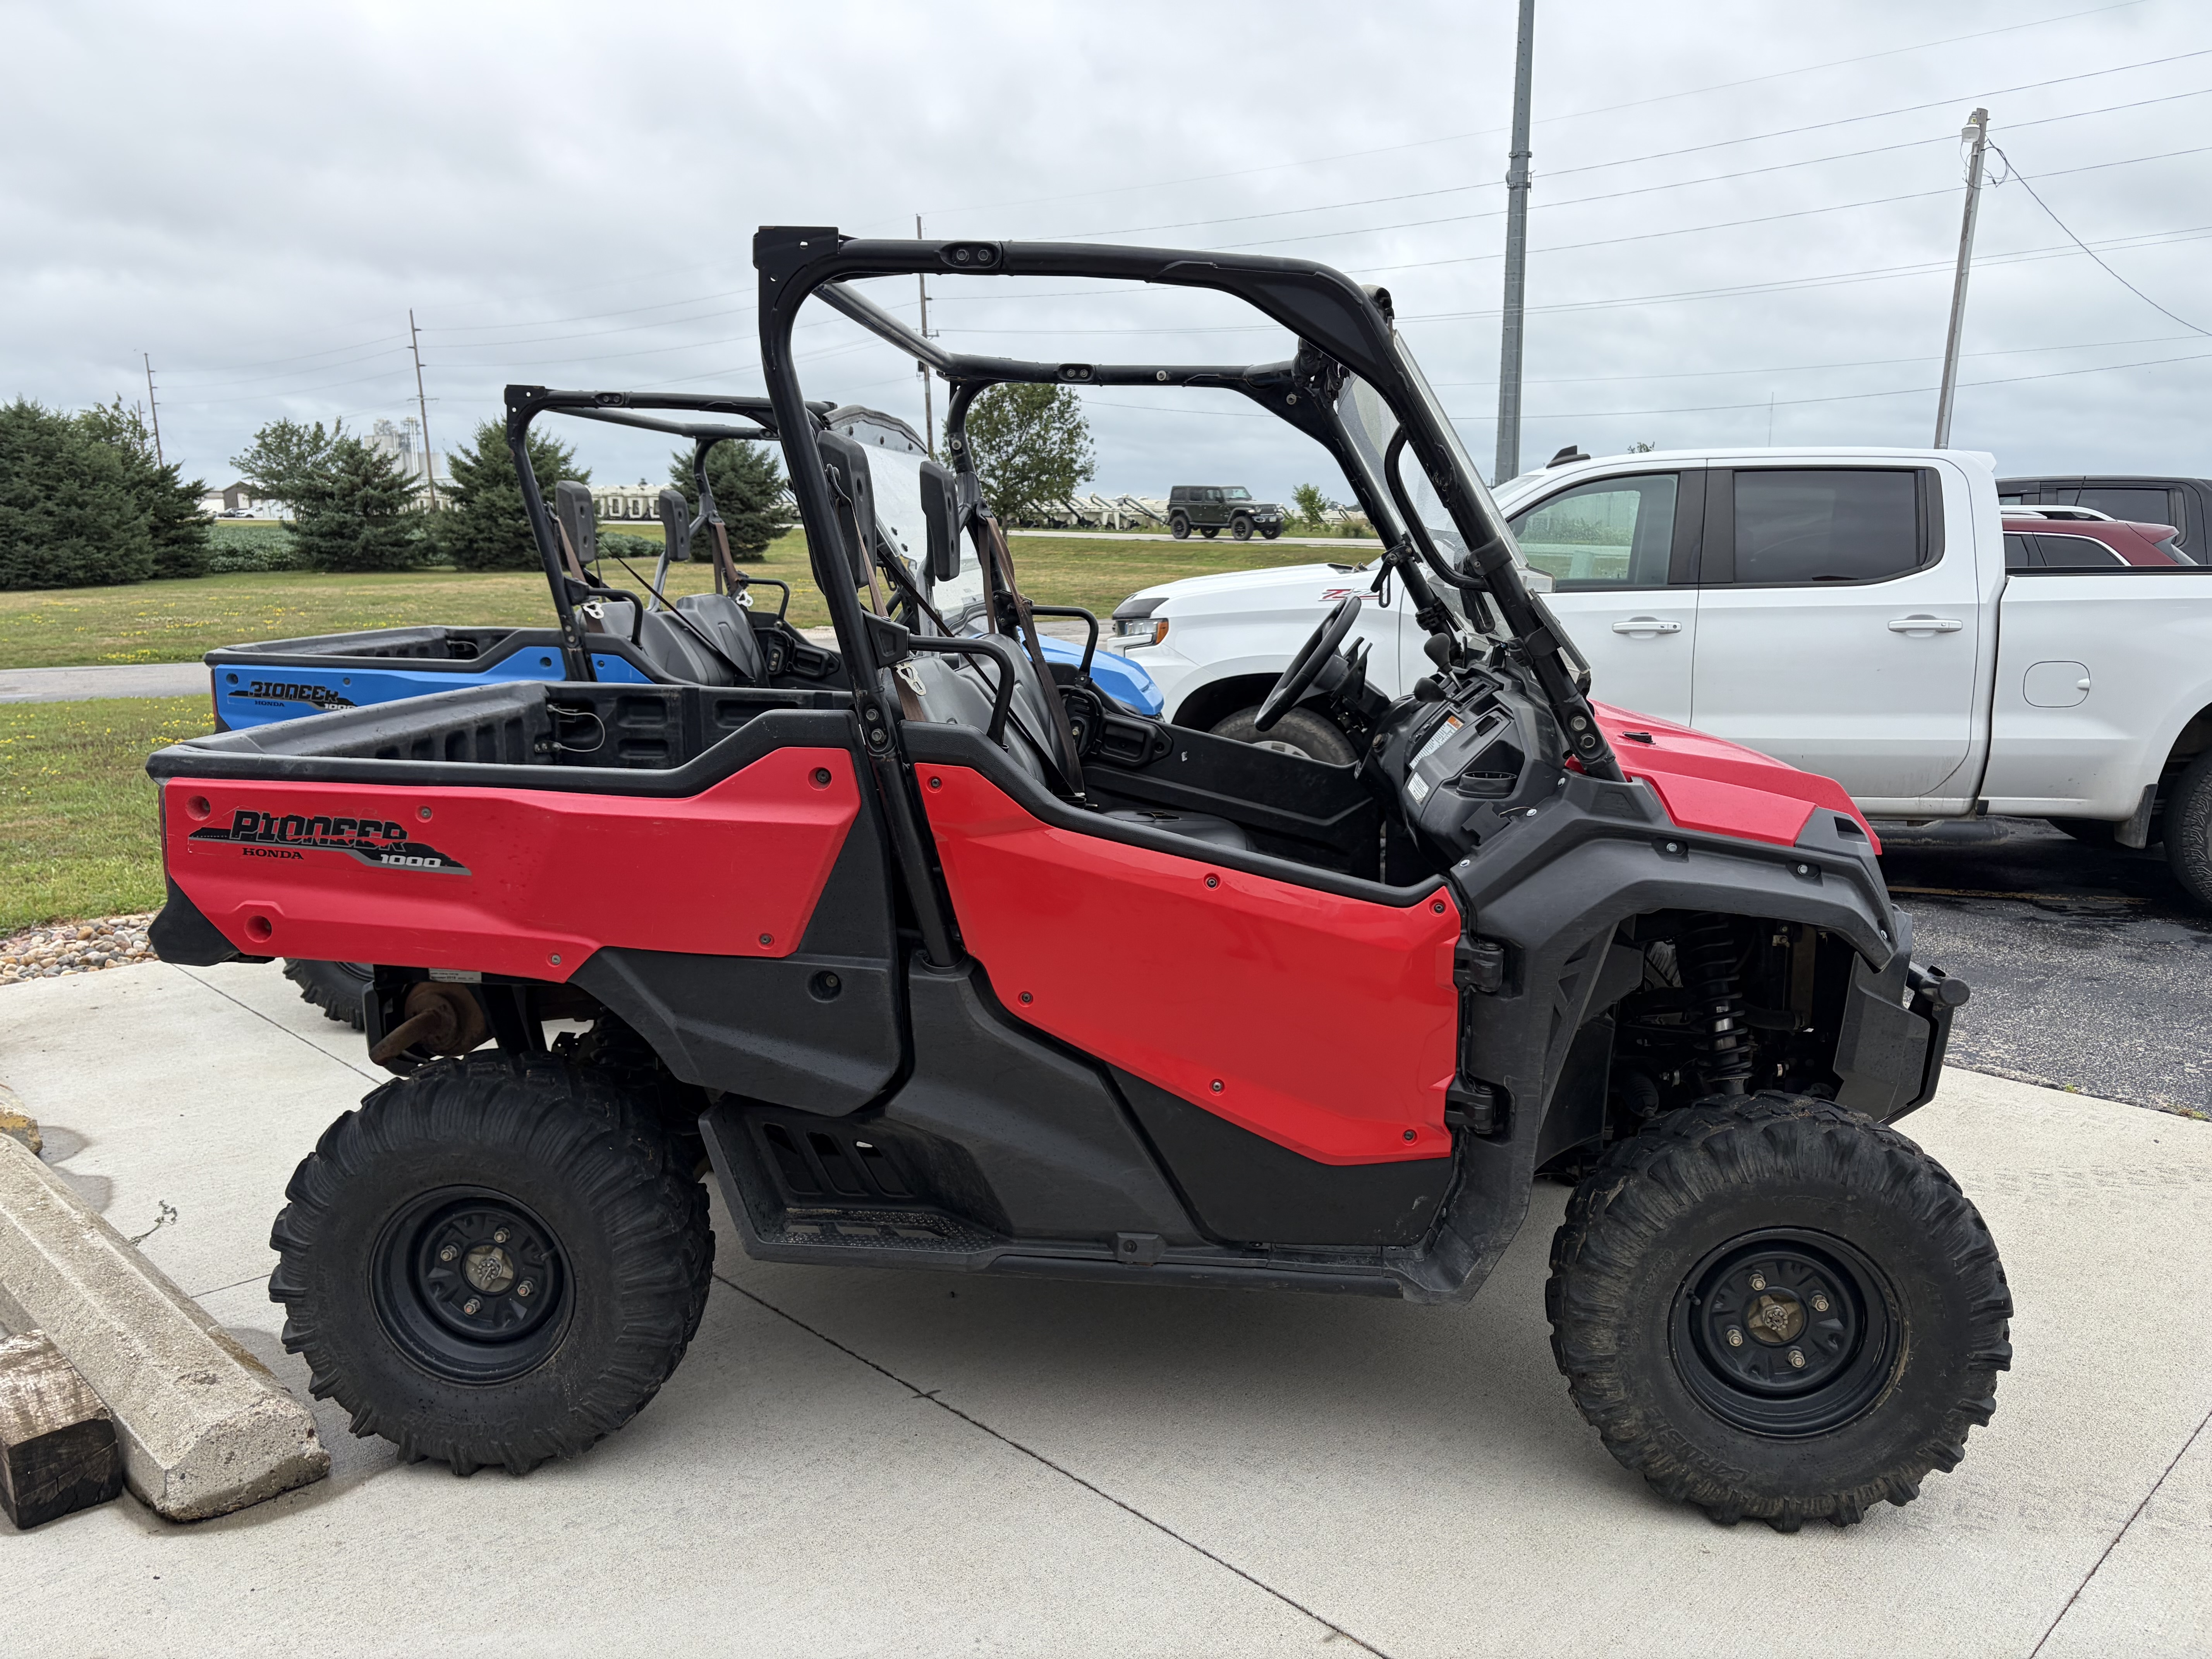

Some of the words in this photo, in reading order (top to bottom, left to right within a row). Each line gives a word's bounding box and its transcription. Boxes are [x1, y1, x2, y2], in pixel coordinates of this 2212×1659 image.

[248, 680, 339, 702] PIONEER
[230, 810, 408, 852] PIONEER
[242, 847, 304, 860] HONDA
[380, 854, 442, 868] 1000
